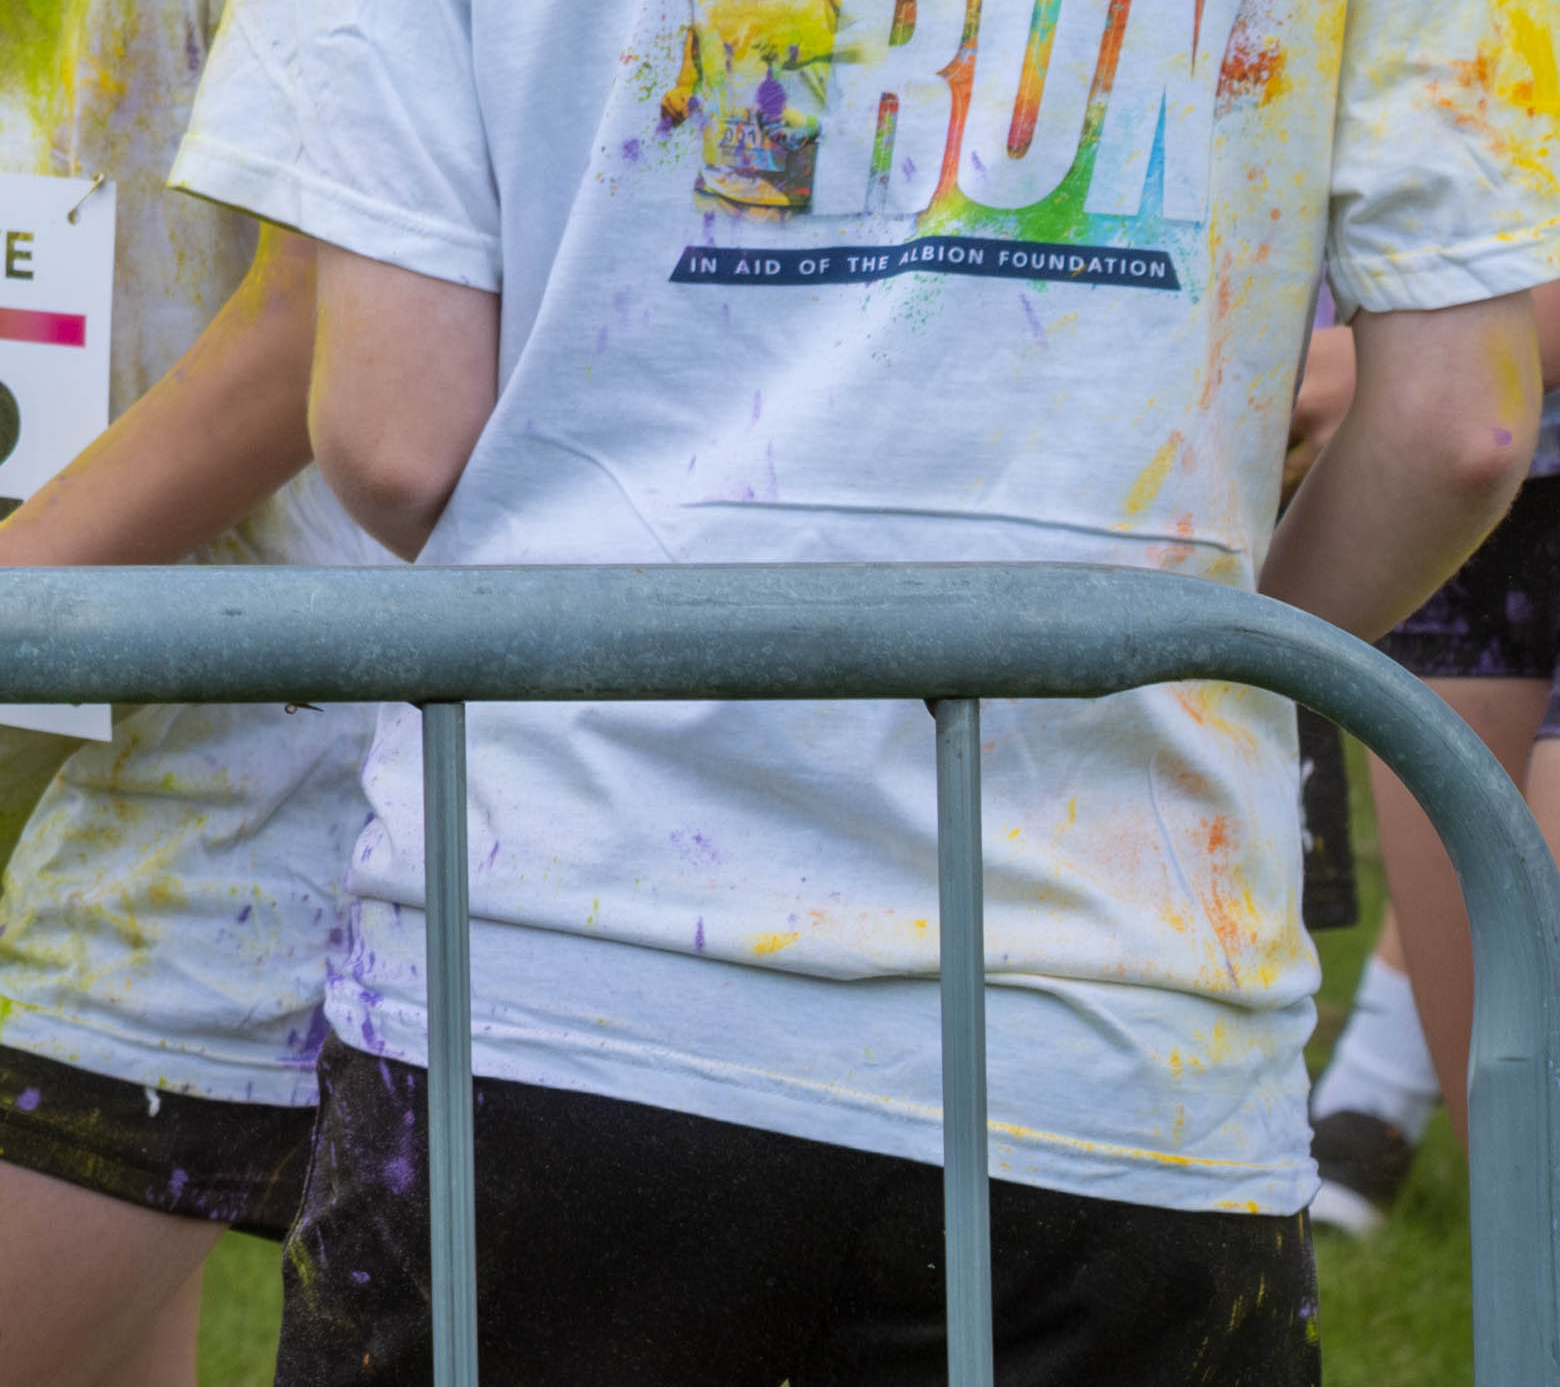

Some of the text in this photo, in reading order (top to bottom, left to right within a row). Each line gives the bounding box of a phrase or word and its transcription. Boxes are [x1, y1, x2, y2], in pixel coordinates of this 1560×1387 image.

[689, 245, 1166, 279] IN AID OF THE ALBION FOUNDATION
